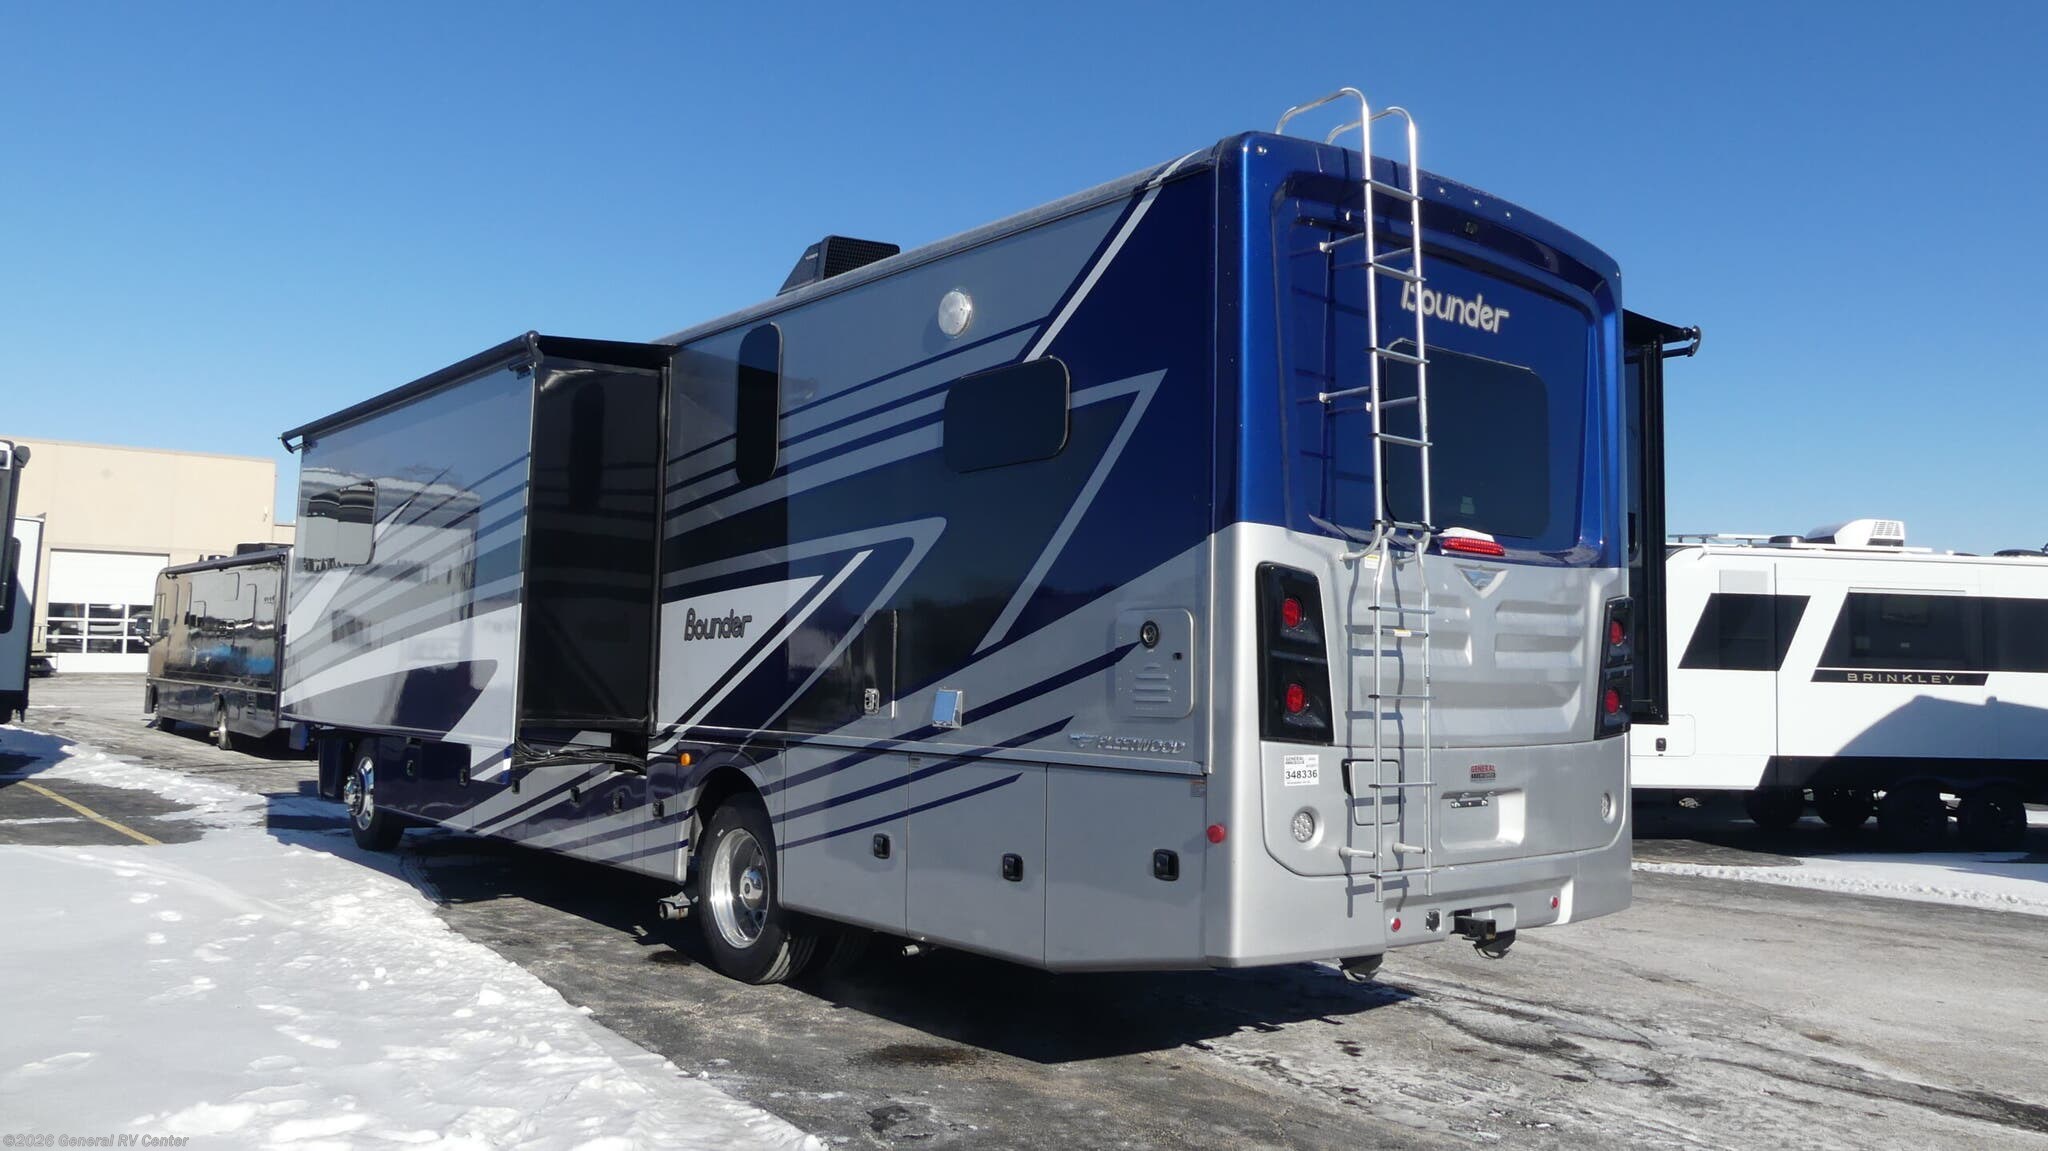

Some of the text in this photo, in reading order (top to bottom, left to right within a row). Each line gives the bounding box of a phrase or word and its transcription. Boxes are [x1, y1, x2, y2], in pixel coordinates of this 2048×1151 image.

[684, 607, 753, 641] Bounder
[1847, 672, 1955, 684] BRINKLEY
[1285, 769, 1318, 780] 348336
